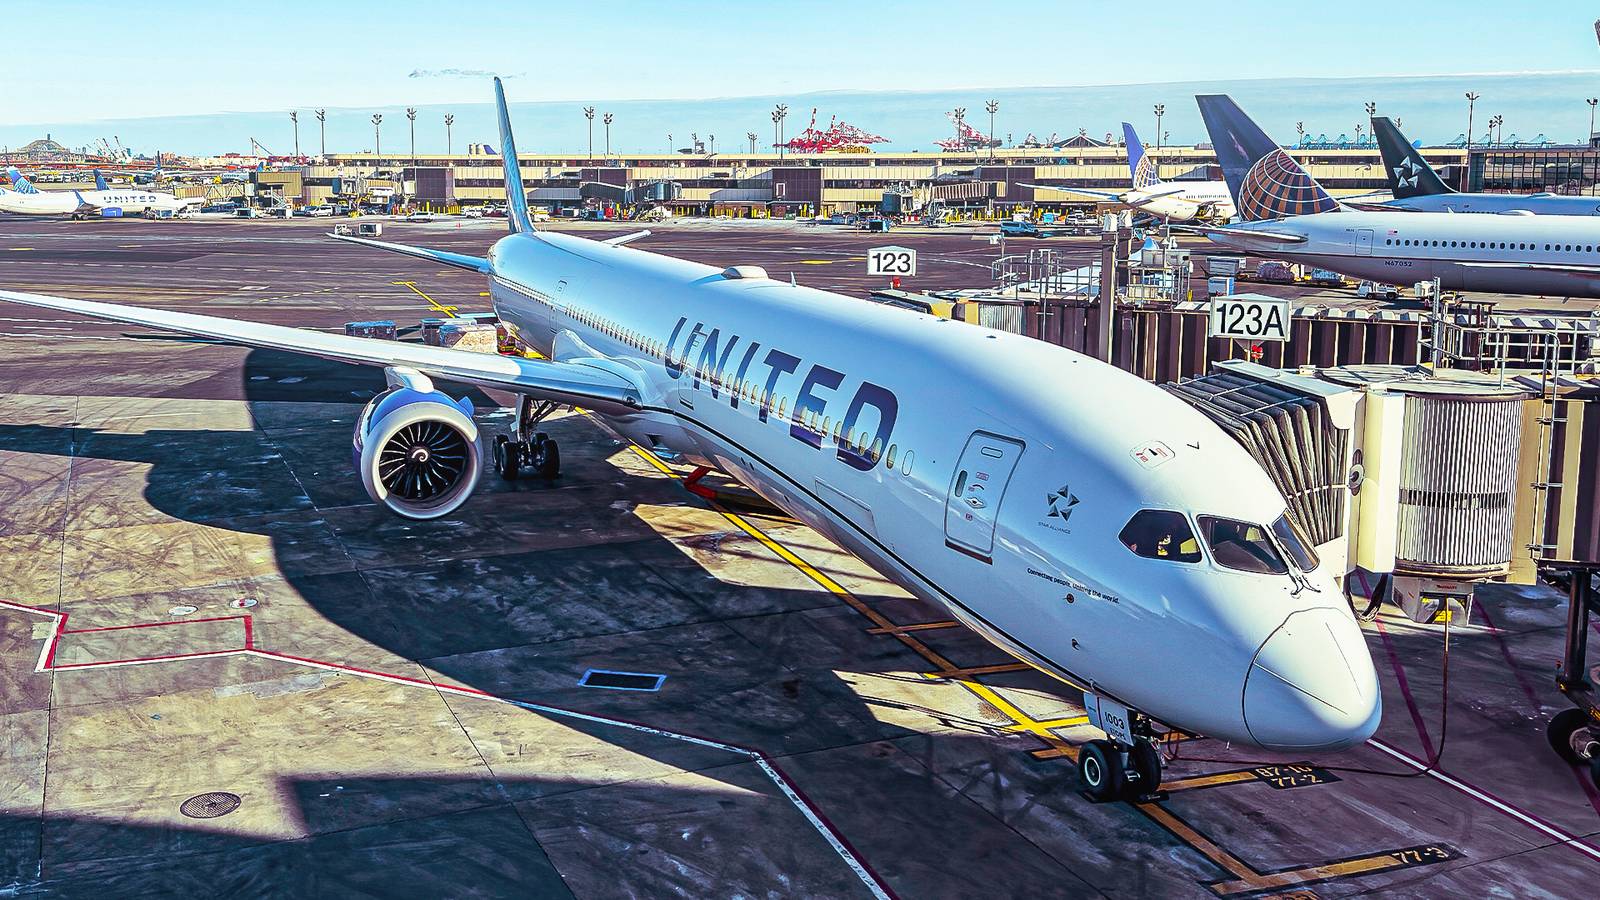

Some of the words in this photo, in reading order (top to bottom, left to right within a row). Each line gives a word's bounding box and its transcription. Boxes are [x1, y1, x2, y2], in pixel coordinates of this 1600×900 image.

[103, 195, 157, 203] UNITED
[872, 252, 911, 273] 123
[1216, 303, 1285, 337] 123A
[664, 316, 899, 472] UNITED
[1027, 567, 1054, 582] Connecting
[1092, 589, 1102, 598] the
[1104, 711, 1125, 730] 1003
[1391, 847, 1449, 864] 77-3
